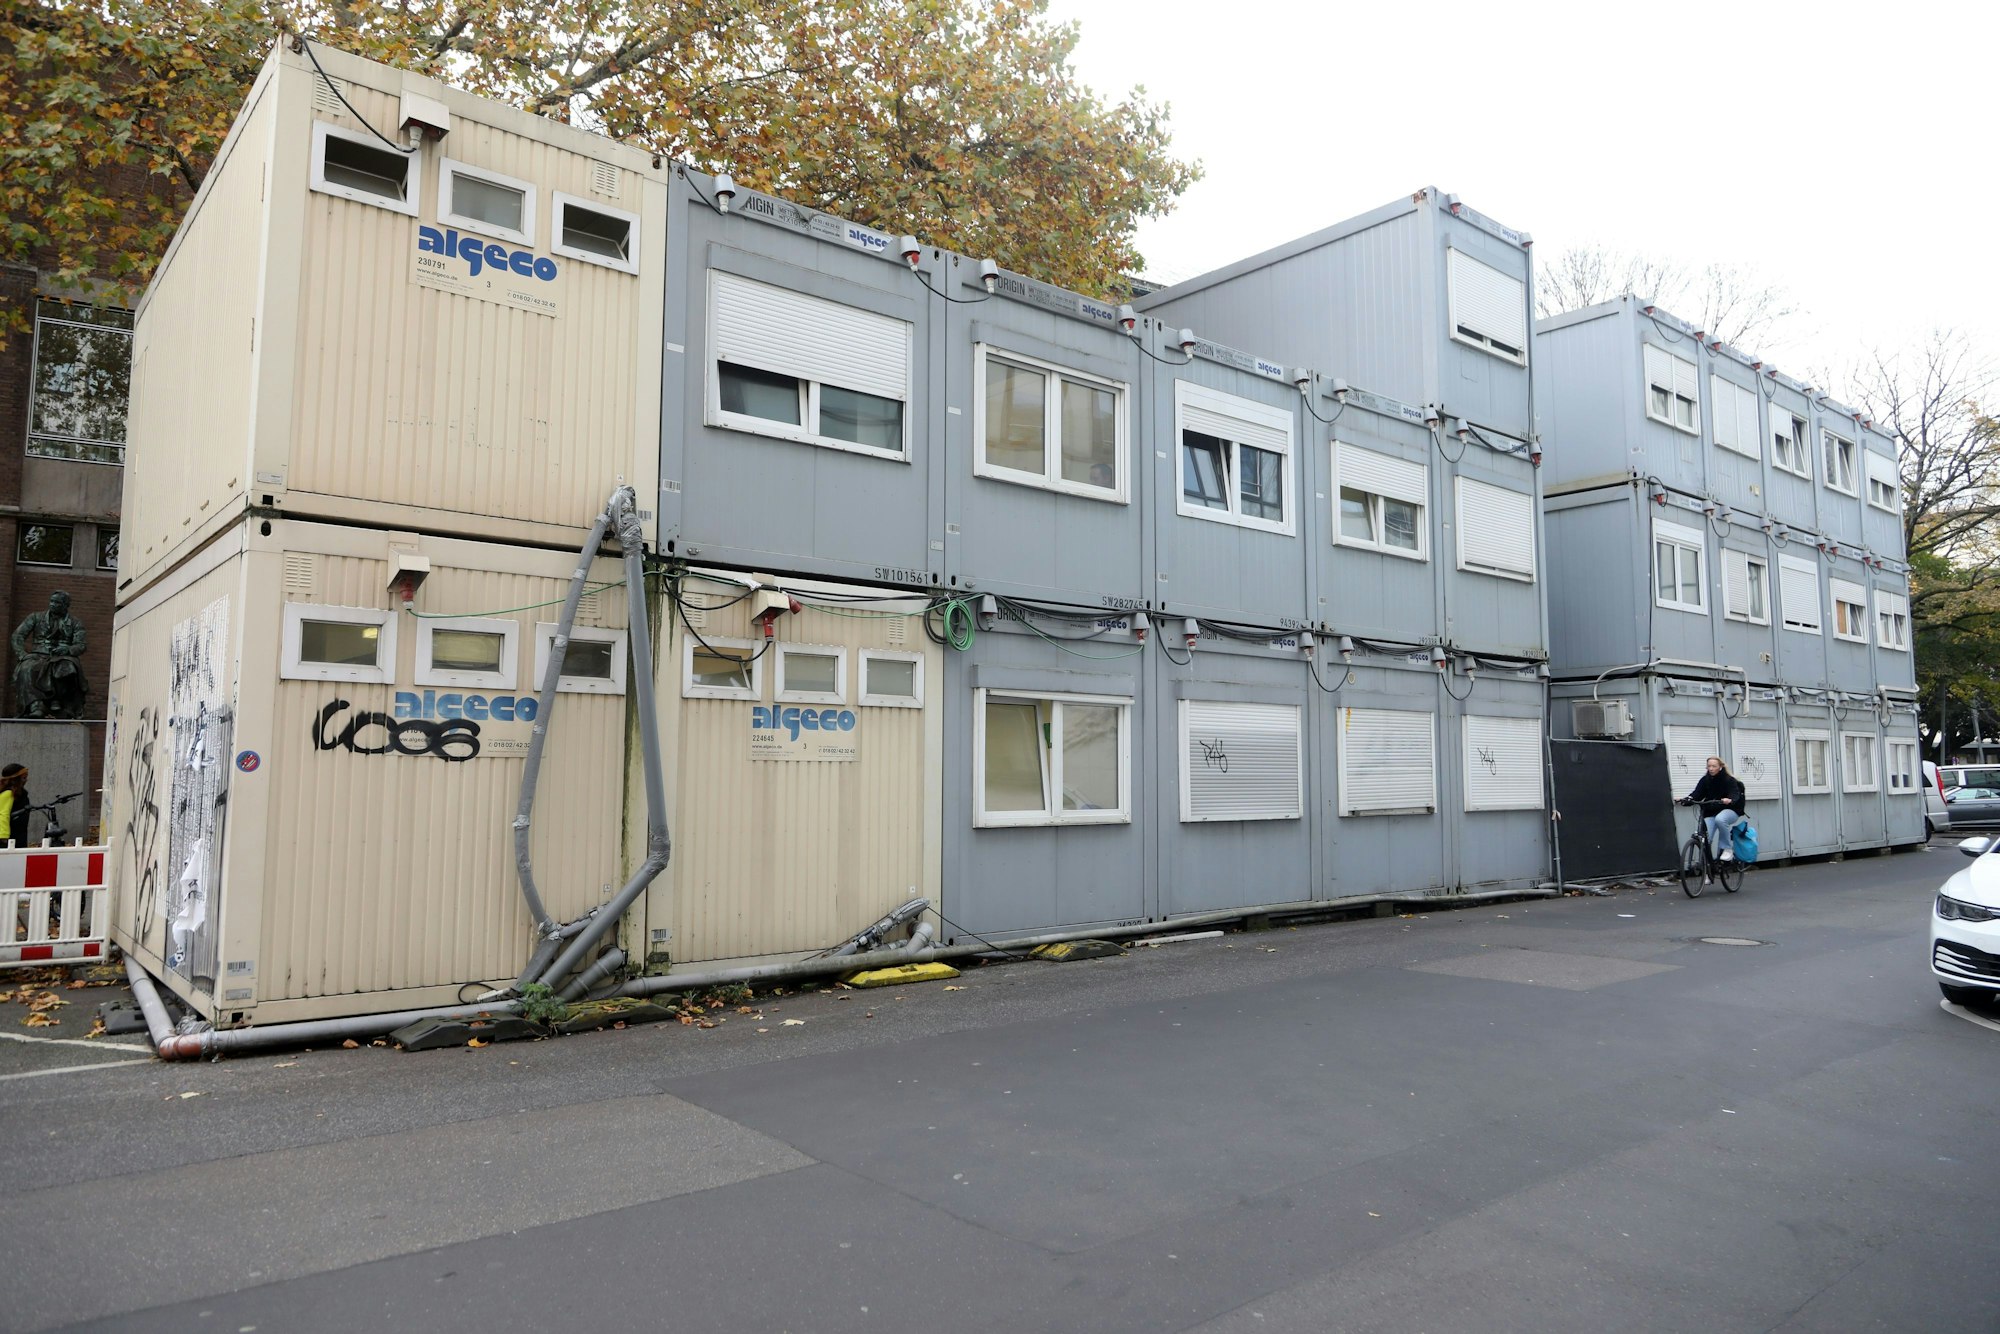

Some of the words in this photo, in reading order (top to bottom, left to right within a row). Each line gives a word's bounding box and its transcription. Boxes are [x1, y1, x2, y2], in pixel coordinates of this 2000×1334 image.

[418, 225, 558, 282] algeco
[418, 257, 446, 270] 230791
[416, 268, 458, 282] www.algeco.de
[486, 280, 492, 288] 3
[997, 276, 1026, 296] ORIGIN
[1082, 303, 1113, 320] algeco
[1257, 362, 1281, 375] algeco
[1403, 407, 1422, 418] algeco
[875, 567, 928, 585] SW101561
[1102, 596, 1143, 609] SW282745
[395, 690, 539, 726] algeco
[752, 705, 856, 742] algeco
[752, 734, 775, 742] 224645
[803, 742, 808, 750] 3
